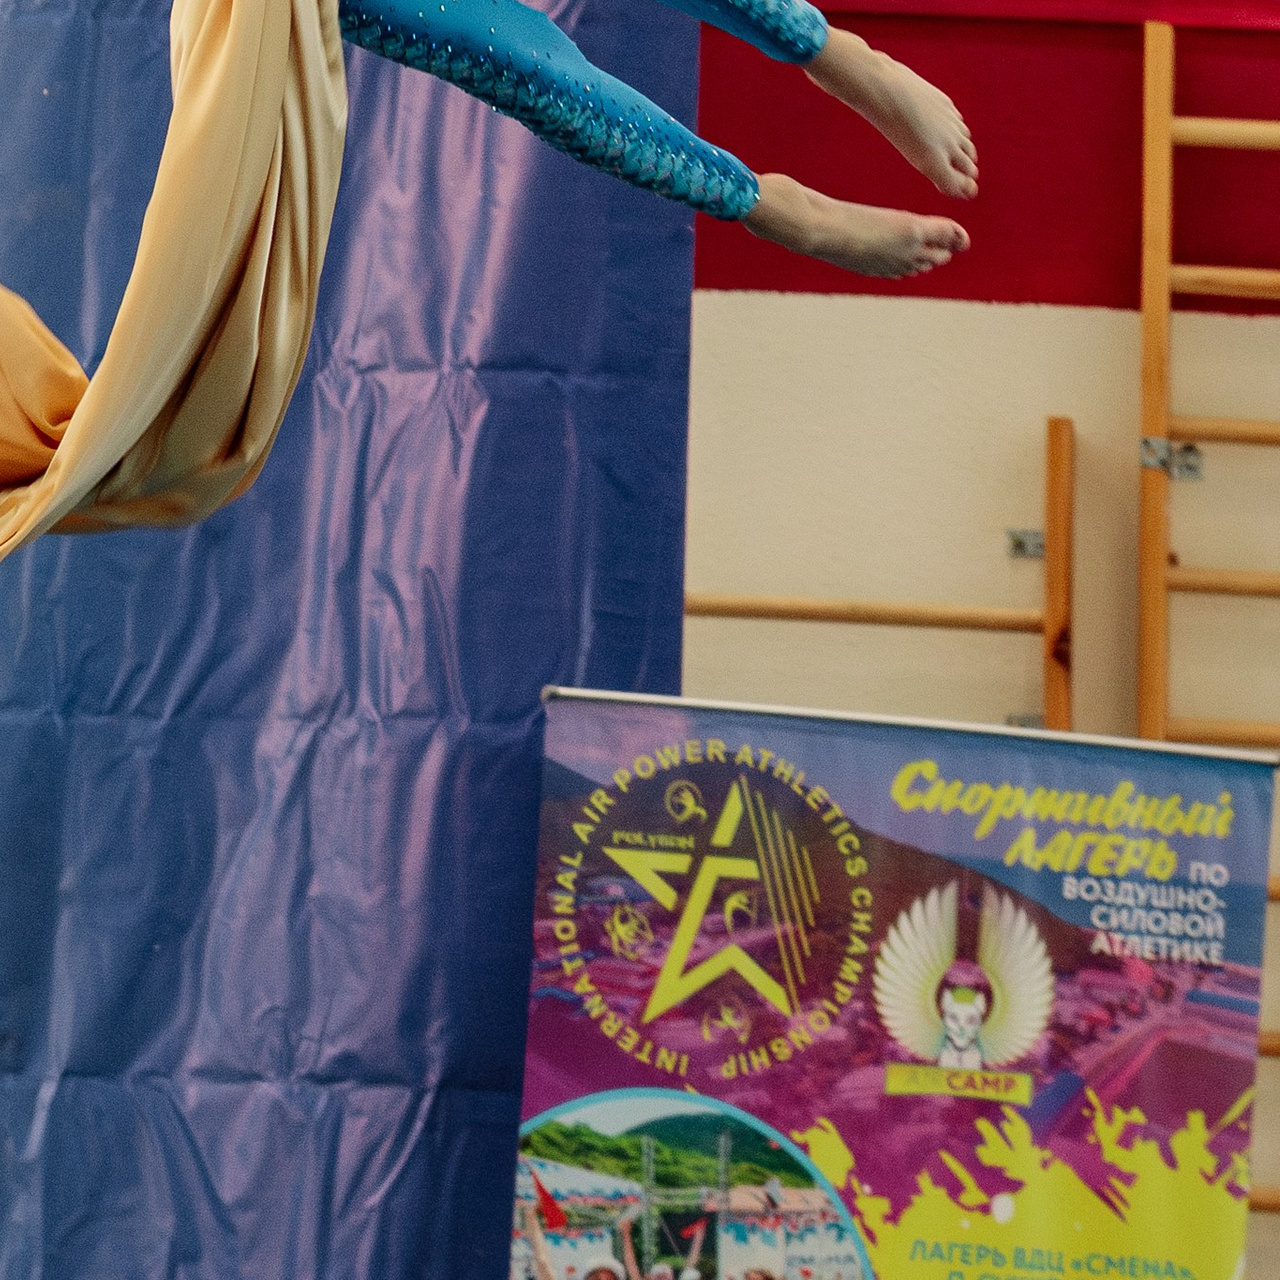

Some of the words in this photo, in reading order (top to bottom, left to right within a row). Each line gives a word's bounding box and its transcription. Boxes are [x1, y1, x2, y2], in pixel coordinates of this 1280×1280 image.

[612, 739, 727, 793] POWER
[572, 787, 615, 842] AIR
[735, 745, 869, 878] ATHLETICS
[890, 759, 1234, 840] Спортивный
[1004, 828, 1178, 881] ЛАГЕРЬ
[1189, 861, 1230, 888] ПО
[1062, 876, 1226, 913] ВОЗДУШНО-
[1091, 904, 1225, 939] СИЛОВОЙ
[553, 850, 689, 1076] INTERNATIONAL
[1091, 936, 1224, 965] АТЛЕТИКЕ
[722, 887, 873, 1080] CHAMPIONSHIP
[947, 1072, 1016, 1093] CAMP
[910, 1239, 1006, 1268] ЛАГЕРЬ
